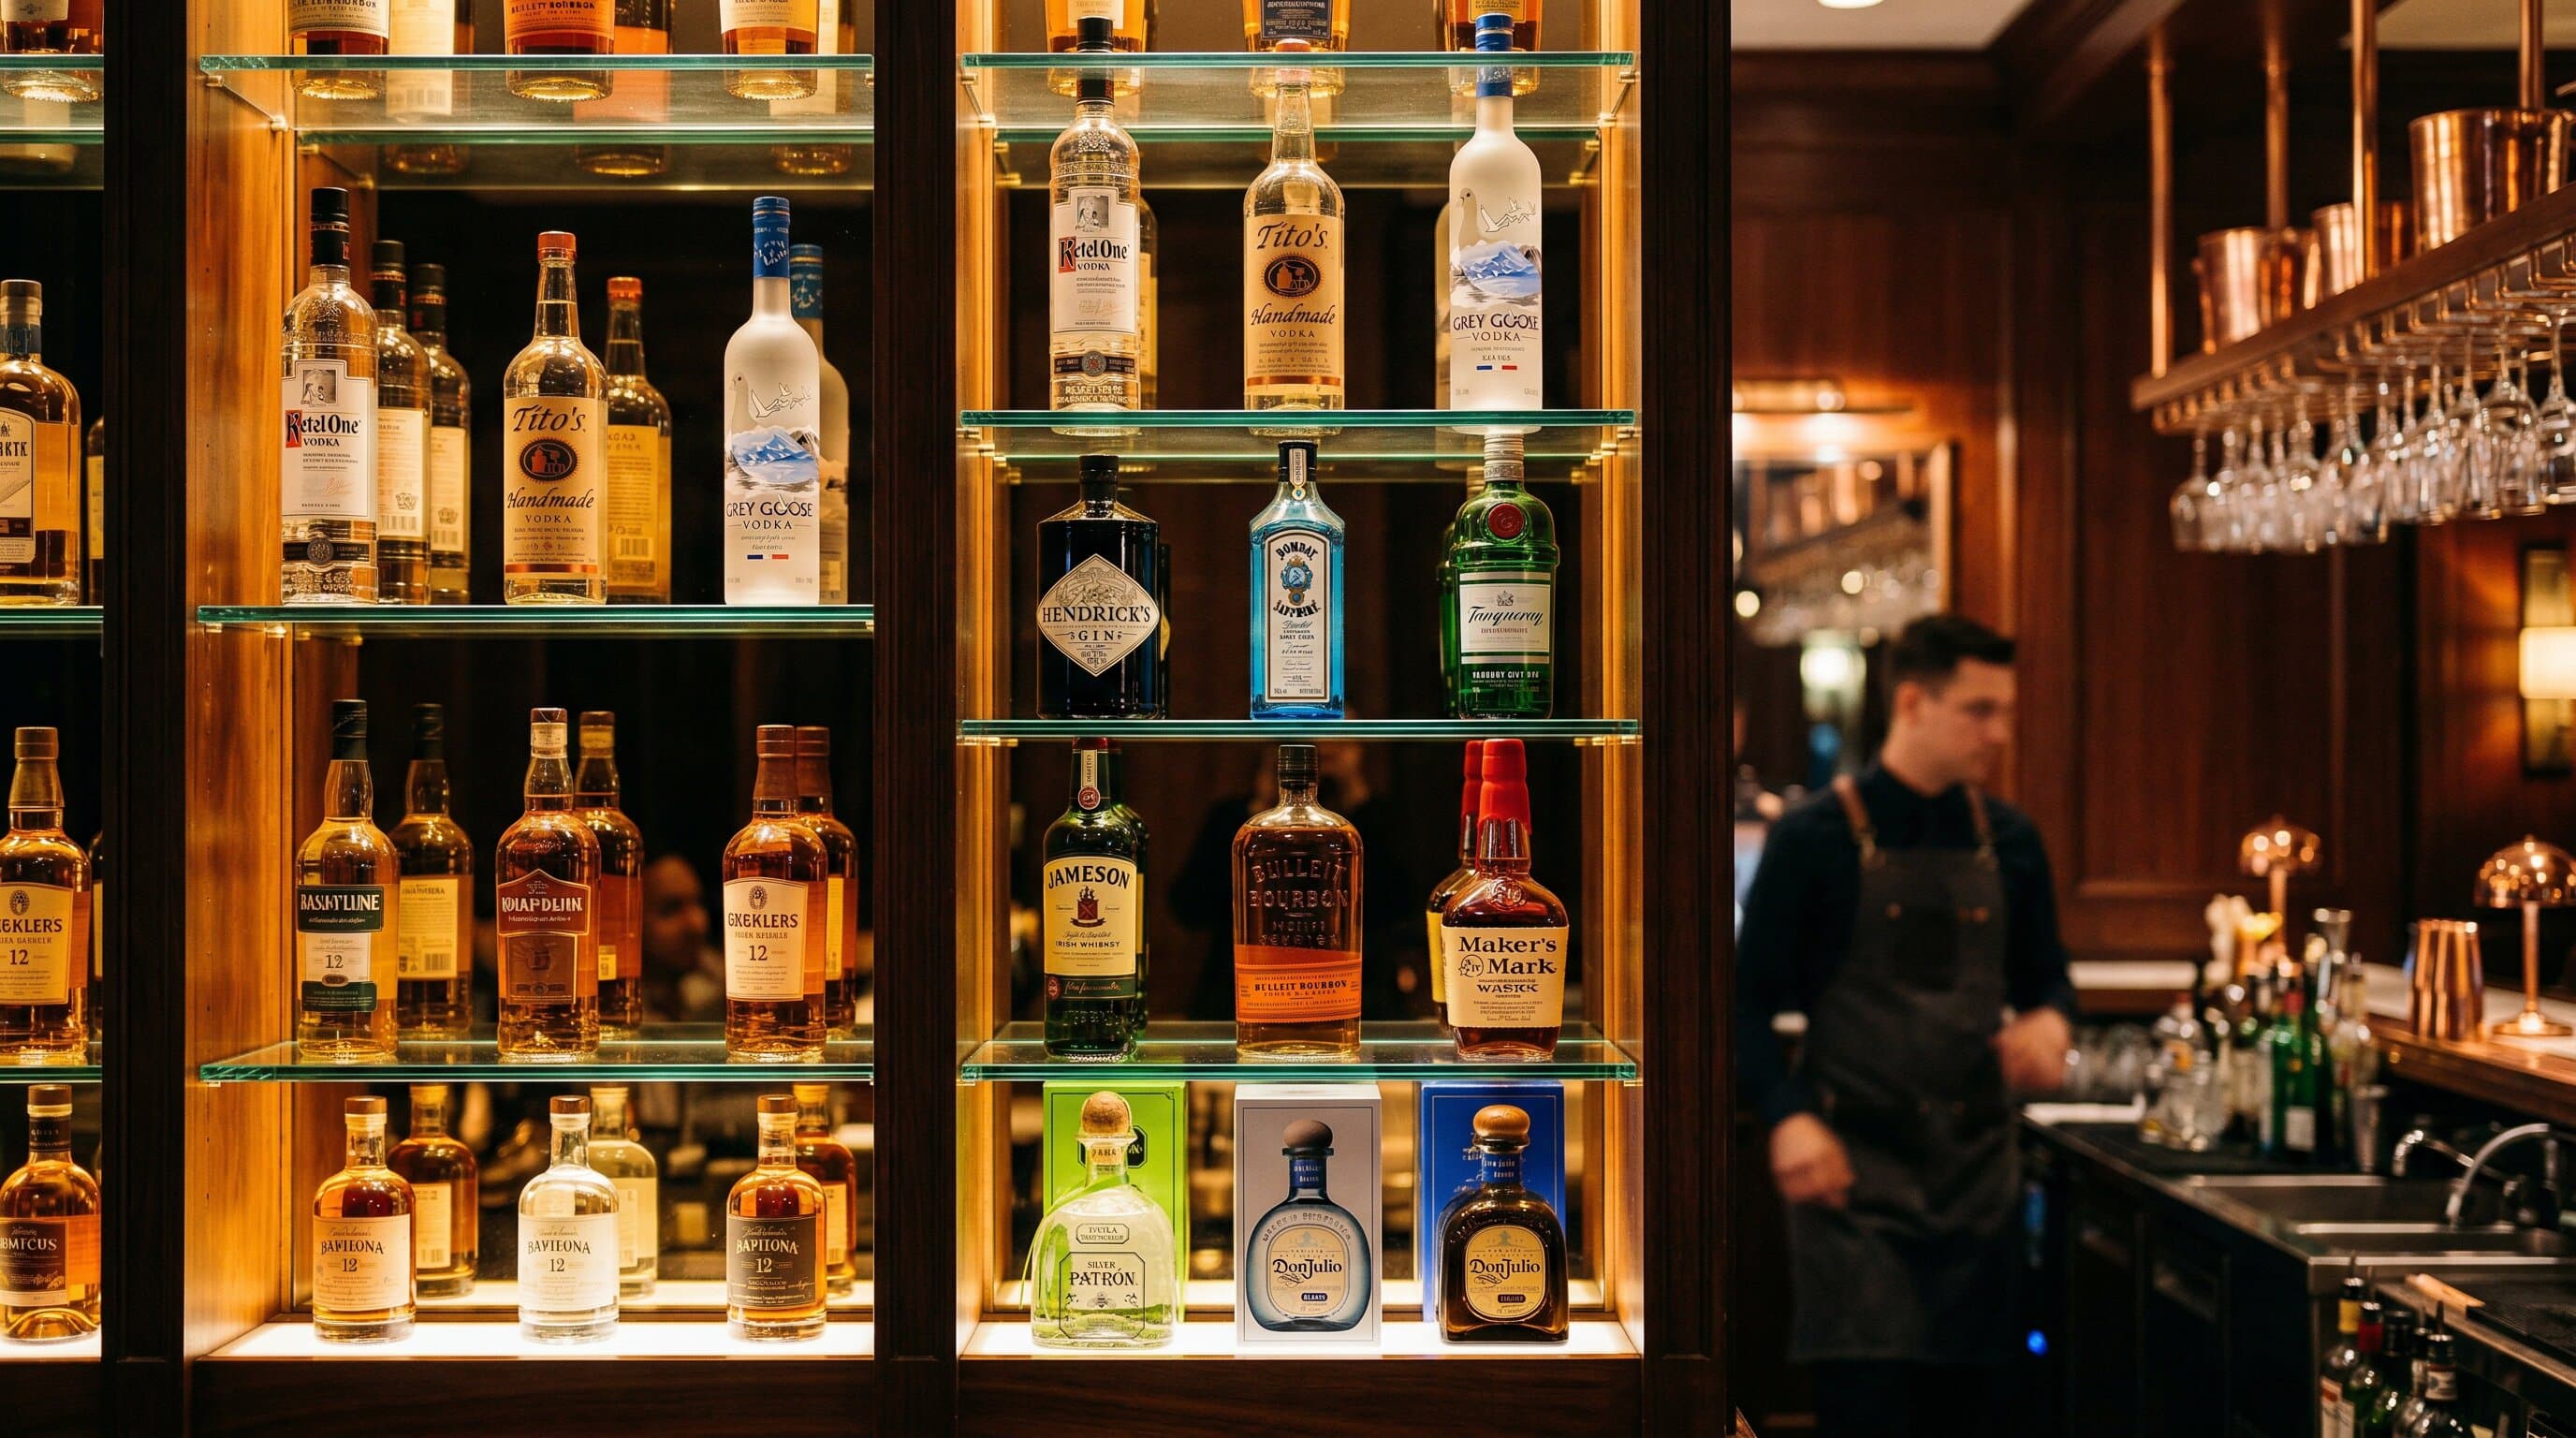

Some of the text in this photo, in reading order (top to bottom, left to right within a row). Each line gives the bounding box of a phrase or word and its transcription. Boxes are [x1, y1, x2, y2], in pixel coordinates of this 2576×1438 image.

[1257, 221, 1328, 249] Tito's
[1100, 240, 1128, 260] One
[1251, 303, 1336, 326] Handmade
[1453, 314, 1486, 330] GREY
[1270, 330, 1315, 338] VODKA
[1471, 331, 1521, 342] VODKA
[513, 404, 587, 433] Tito's
[286, 412, 359, 444] Ketel One
[303, 437, 340, 447] VODKA
[507, 487, 594, 510] Handmade
[726, 501, 813, 517] GREY GOOSE
[525, 515, 571, 523] VODKA
[743, 520, 792, 530] VODKA
[1043, 606, 1150, 623] HENDRICK'S
[1468, 606, 1544, 626] Tanqueray
[1078, 630, 1116, 641] GIN
[1048, 865, 1131, 889] JAMESON
[1457, 936, 1558, 953] Maker's
[9, 948, 29, 965] 12
[749, 945, 768, 961] 12
[325, 954, 344, 969] 12
[1486, 958, 1558, 975] Mark
[343, 1257, 358, 1272] 12
[549, 1257, 565, 1272] 12
[755, 1257, 772, 1273] 12
[1070, 1268, 1136, 1286] PATRÓN
